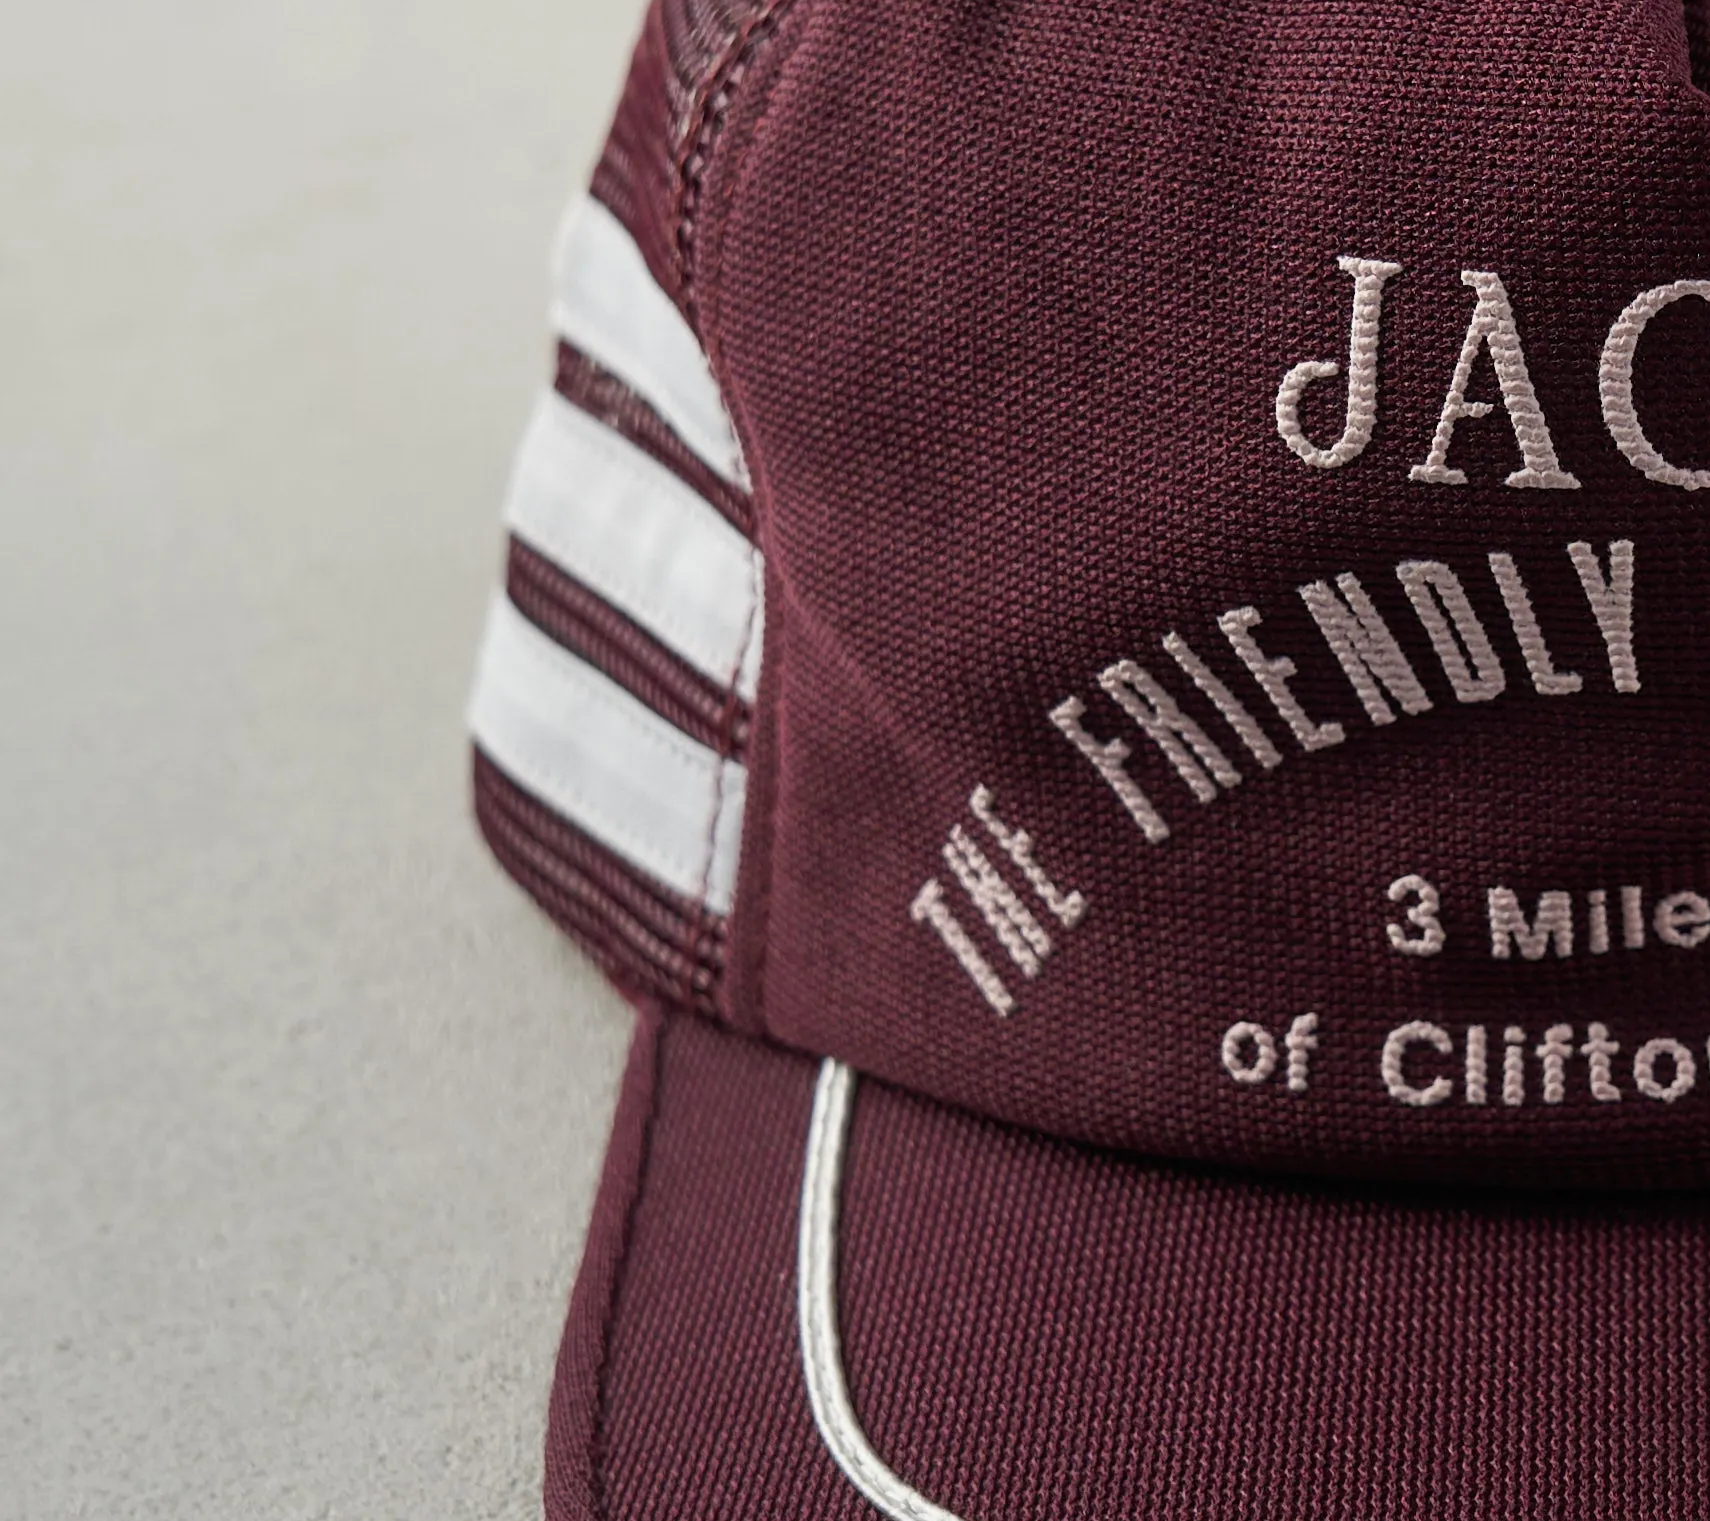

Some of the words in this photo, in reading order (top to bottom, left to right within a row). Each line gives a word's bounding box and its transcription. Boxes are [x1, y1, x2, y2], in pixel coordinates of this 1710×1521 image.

[910, 783, 1088, 1017] THE
[1048, 538, 1641, 841] FRIENDLY
[1386, 874, 1446, 954] 3
[1221, 1011, 1318, 1092] of
